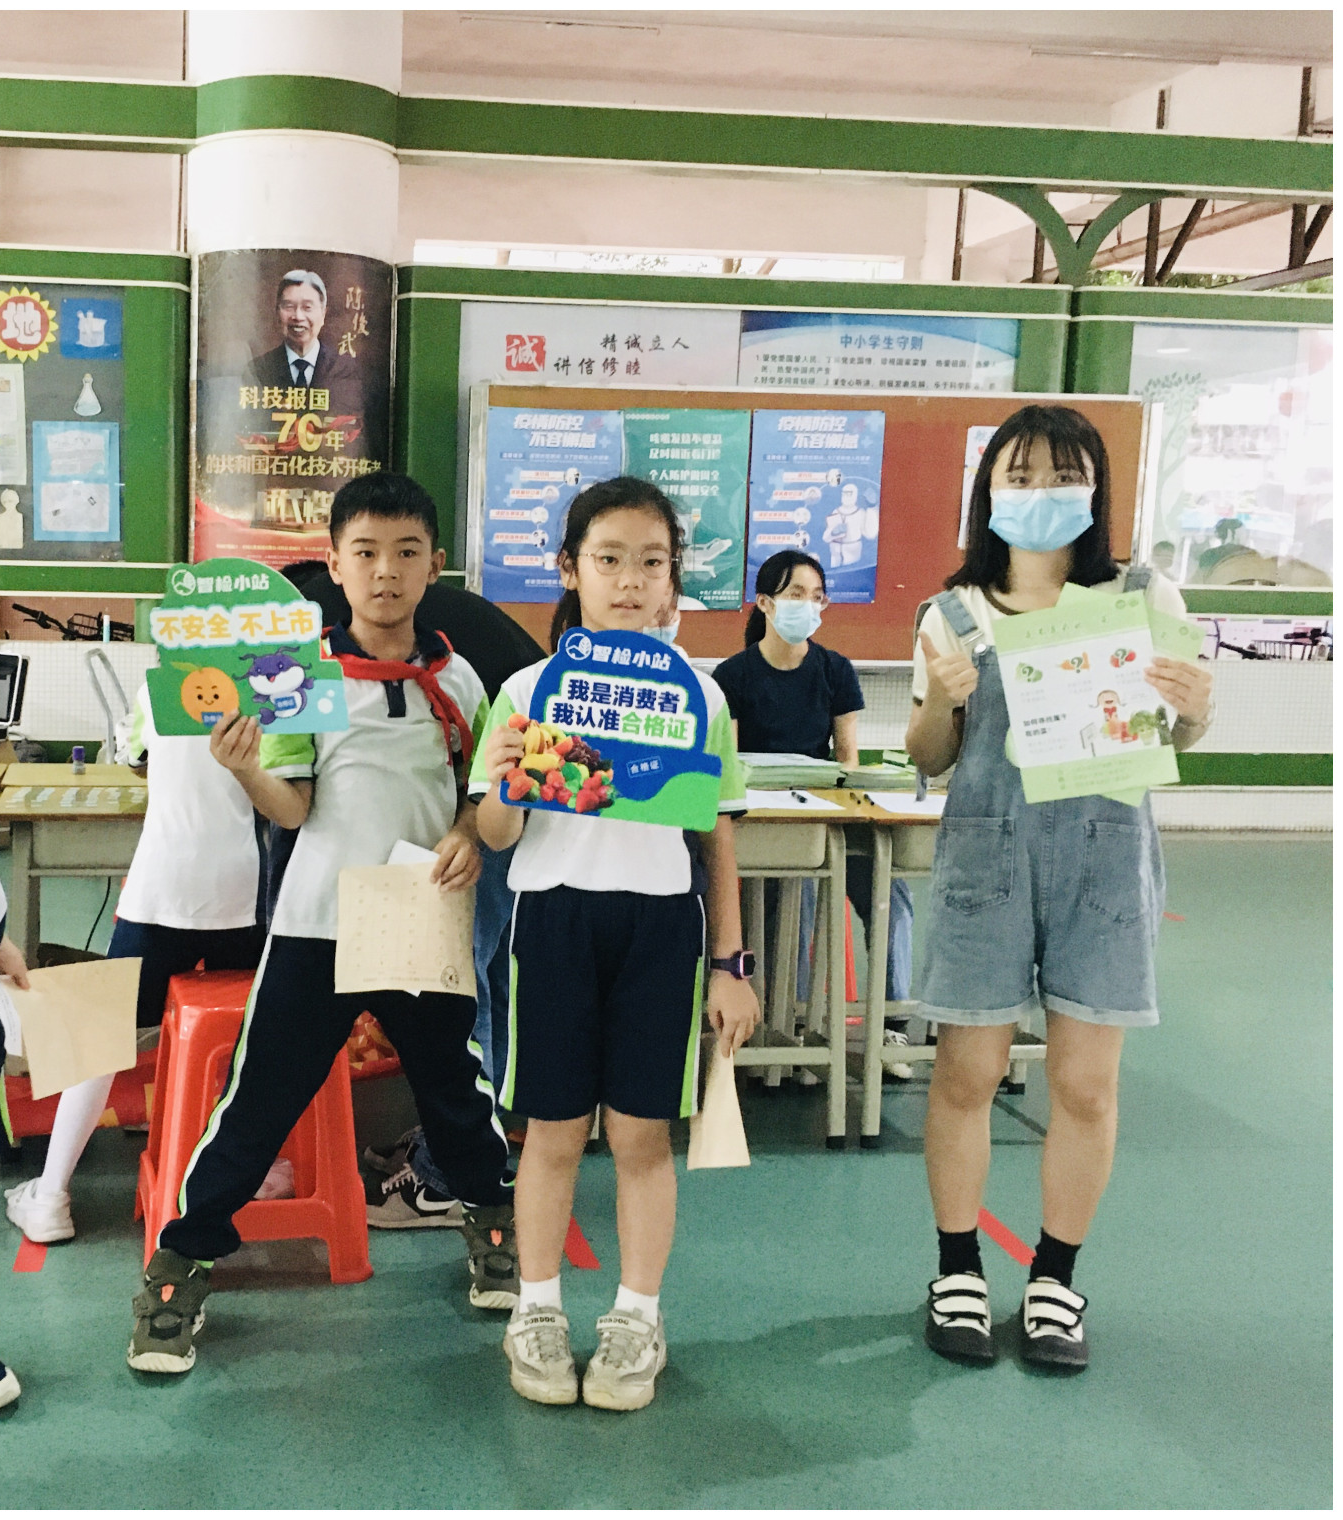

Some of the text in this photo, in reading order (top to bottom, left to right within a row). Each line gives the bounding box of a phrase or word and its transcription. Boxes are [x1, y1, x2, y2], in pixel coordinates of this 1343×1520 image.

[601, 333, 689, 353] 精诚立人
[840, 334, 923, 350] 中小学生守则
[554, 356, 642, 377] 讲信修睦
[239, 386, 330, 411] 科技报国
[197, 573, 270, 594] 智检小站
[156, 608, 314, 641] 不安全 不上市
[591, 644, 672, 671] 智检小站
[567, 678, 681, 714] 我是消费者
[552, 702, 689, 740] 我认准合格证
[630, 759, 660, 775] 合格证
